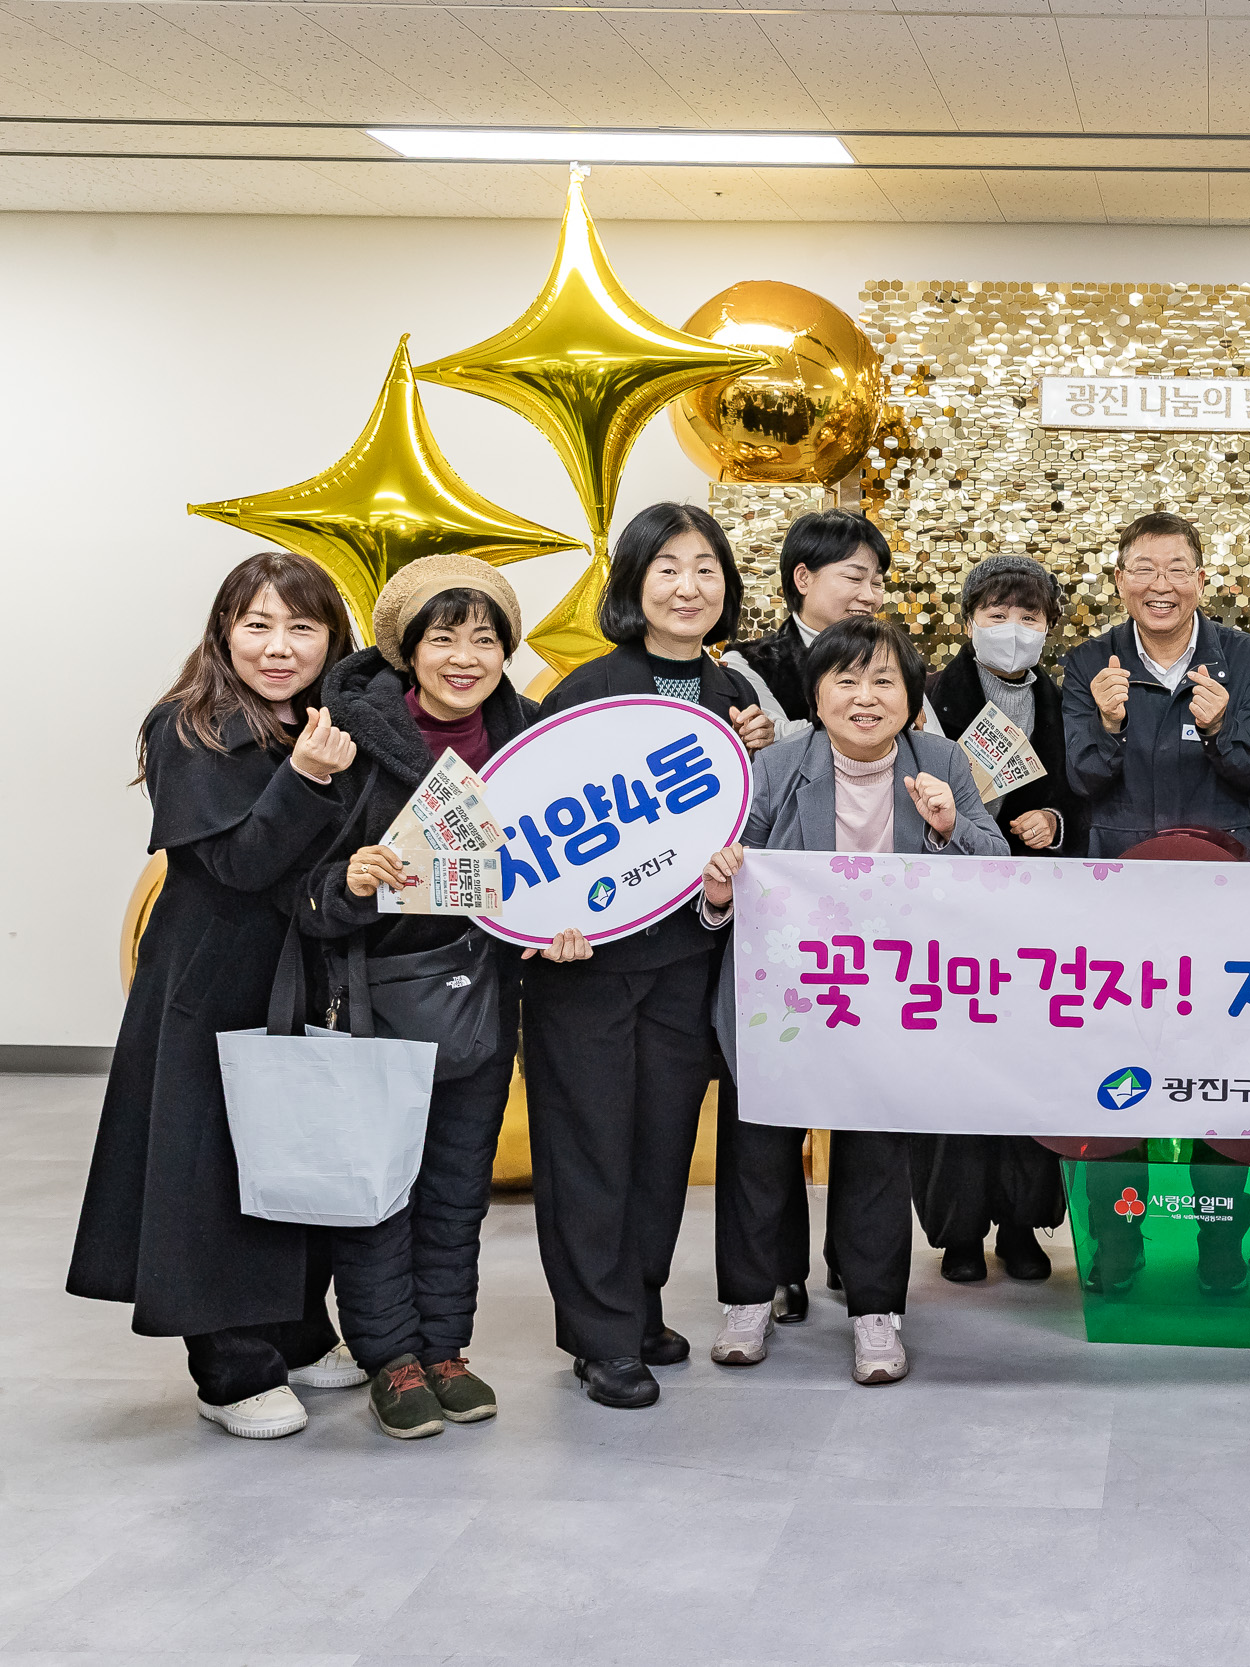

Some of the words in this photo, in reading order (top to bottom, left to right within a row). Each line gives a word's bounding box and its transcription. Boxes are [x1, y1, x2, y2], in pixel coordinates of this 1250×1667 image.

[1066, 384, 1128, 417] 광진
[1139, 385, 1232, 419] 나눔의
[970, 730, 1002, 761] 겨울나기
[976, 721, 1008, 755] 따뜻한
[456, 805, 469, 823] 2026
[497, 733, 721, 902] 자양4동
[448, 858, 459, 907] 겨울나기
[459, 858, 474, 908] 따뜻한
[473, 859, 481, 878] 2026
[621, 849, 678, 887] 광진구
[799, 936, 1011, 1029] 꽃길만
[1018, 946, 1193, 1028] 걷자!
[1148, 1195, 1196, 1213] 사랑의
[1199, 1195, 1234, 1214] 열매
